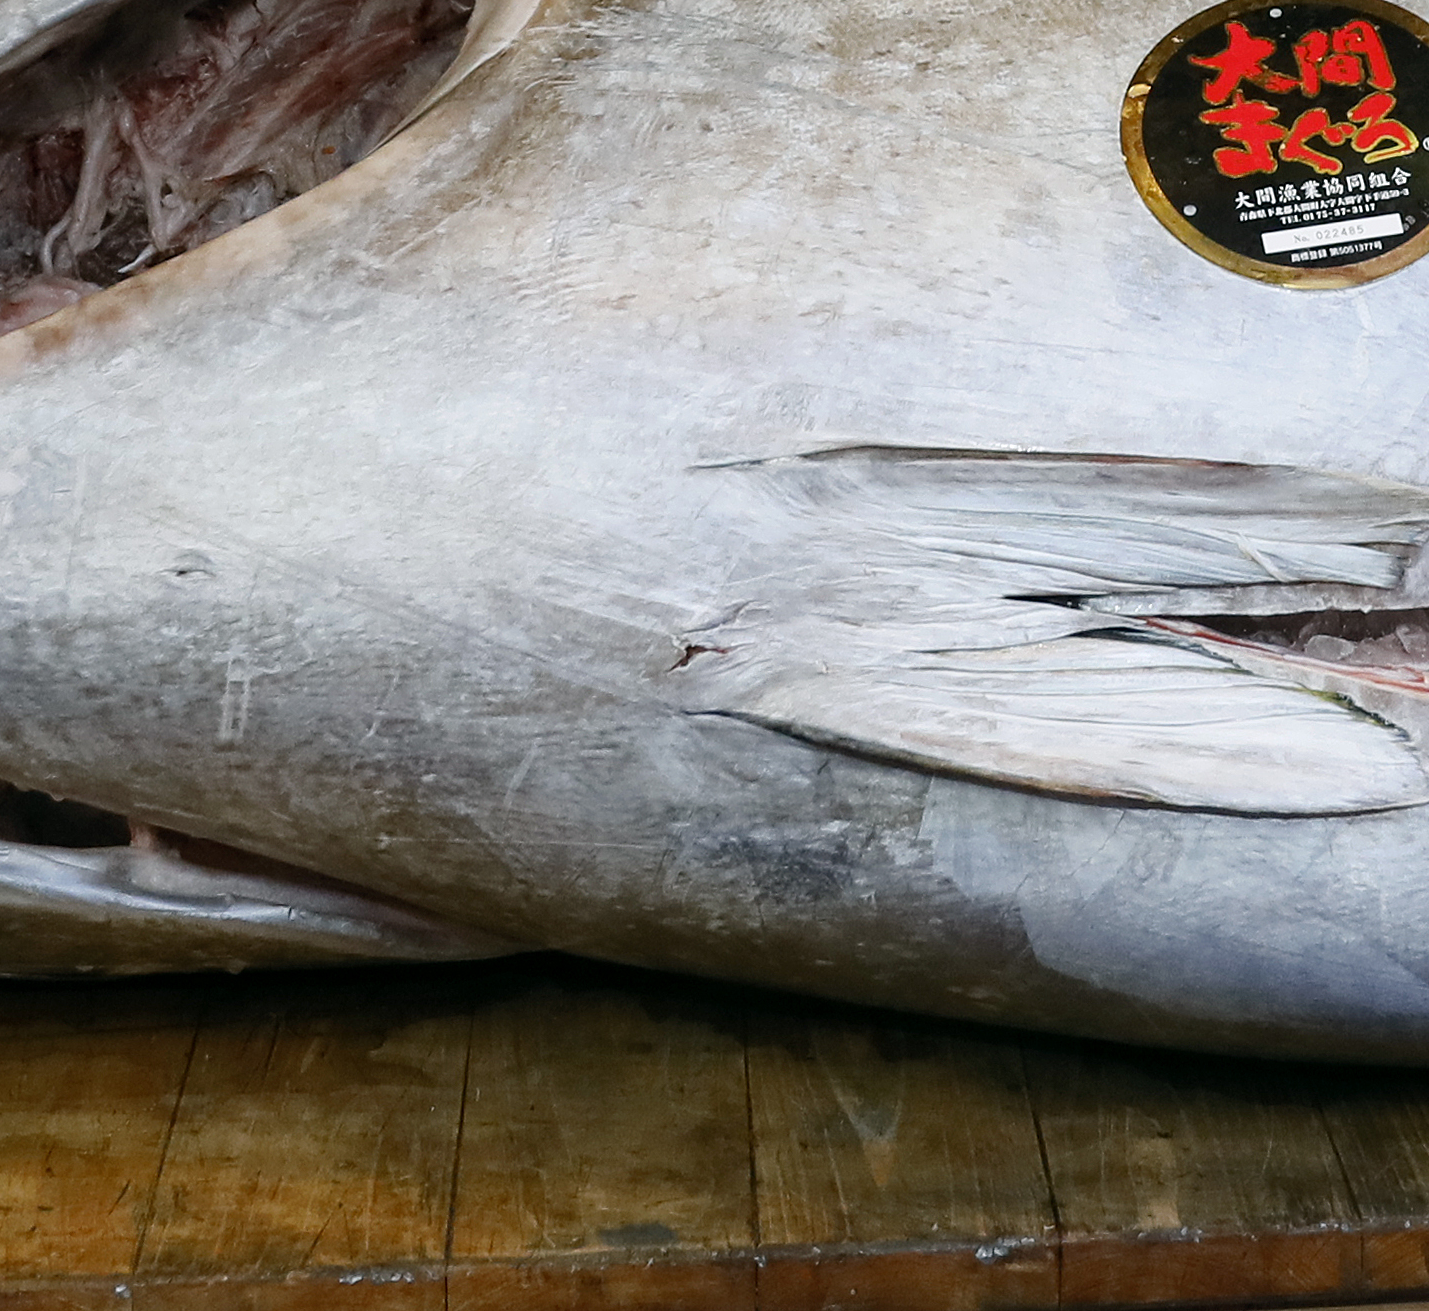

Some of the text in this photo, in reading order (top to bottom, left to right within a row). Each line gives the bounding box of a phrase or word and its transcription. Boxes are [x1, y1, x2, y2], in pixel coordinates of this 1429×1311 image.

[1188, 18, 1396, 105] 大間
[1199, 89, 1420, 177] まぐろ
[1234, 166, 1412, 210] 大間漁業協同組合
[1316, 225, 1365, 242] 022485
